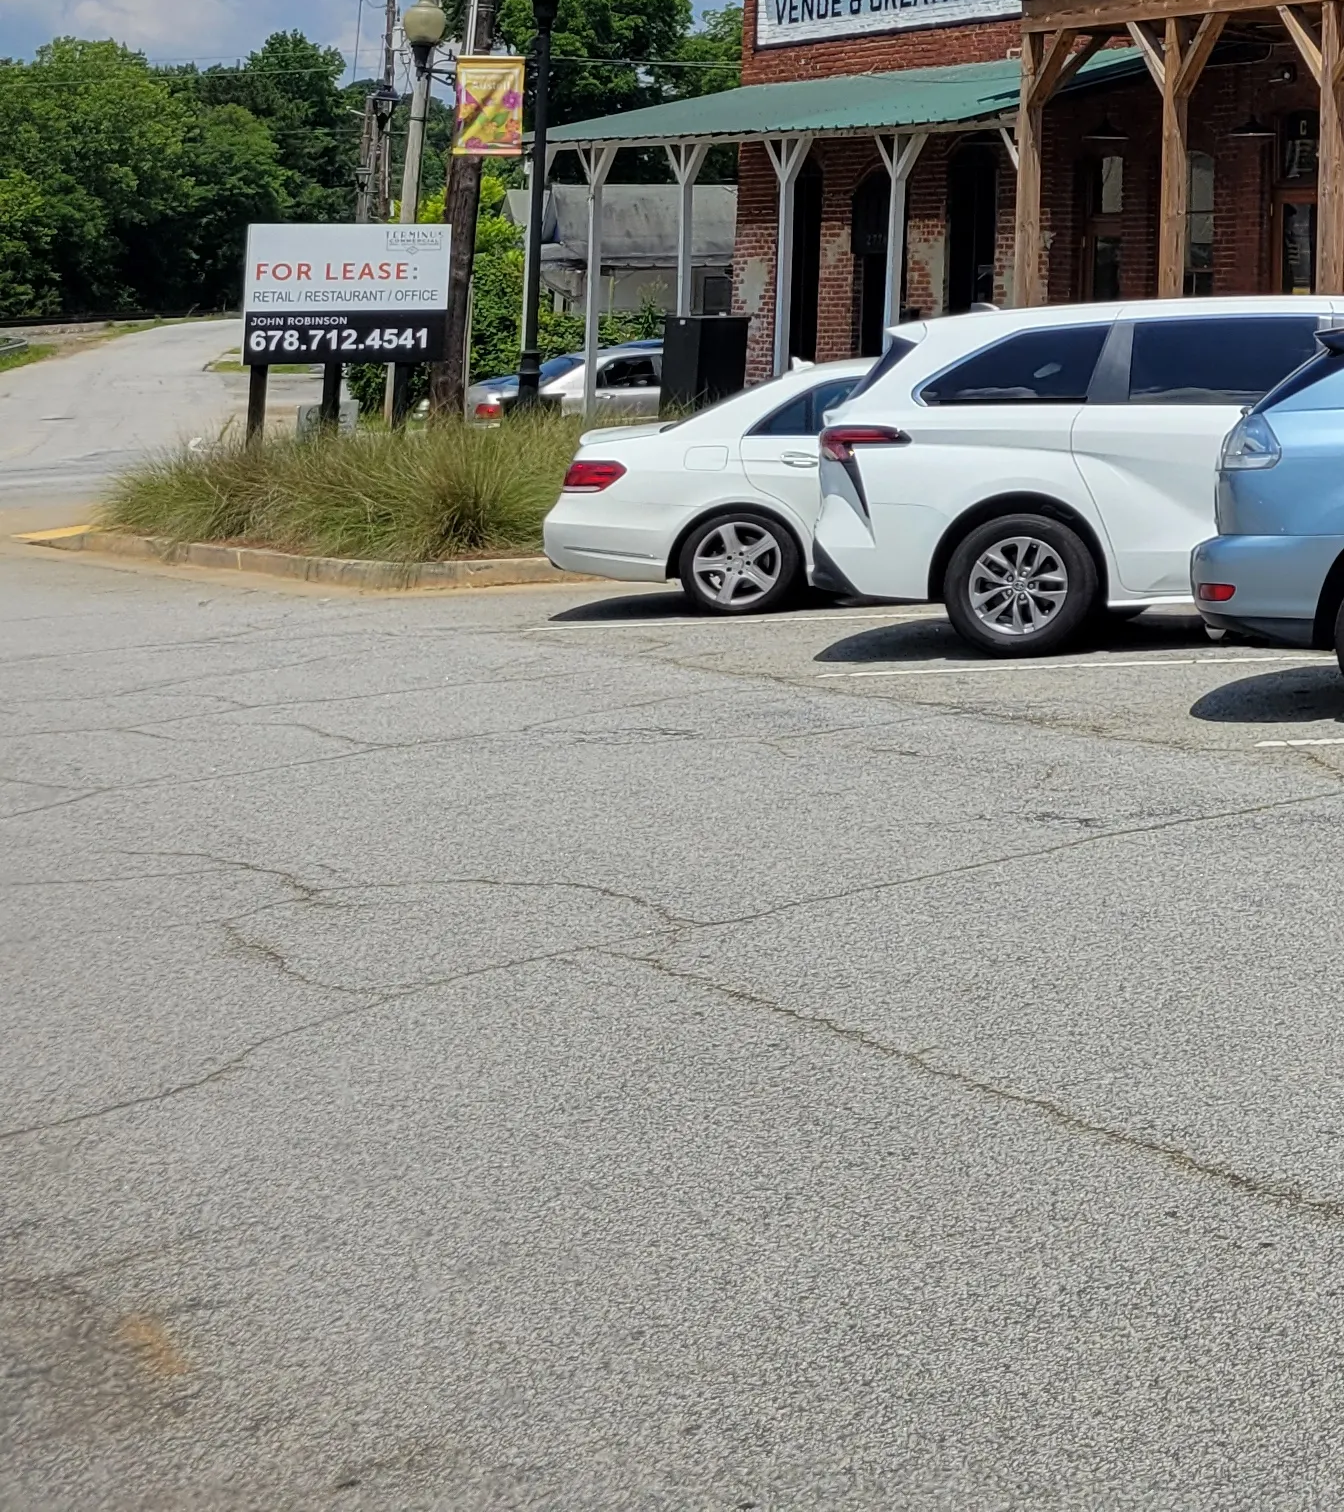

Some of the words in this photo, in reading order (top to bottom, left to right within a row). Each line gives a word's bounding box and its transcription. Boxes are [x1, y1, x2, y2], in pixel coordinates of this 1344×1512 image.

[386, 230, 444, 239] TERMINUS
[255, 263, 312, 281] FOR
[325, 262, 419, 281] LEASE:
[253, 290, 295, 303] RETAIL
[304, 289, 386, 302] RESTAURANT
[395, 289, 438, 302] OFFICE
[250, 317, 284, 327] JOHN
[287, 316, 348, 326] ROBINSON
[249, 328, 428, 352] 678.712.4541
